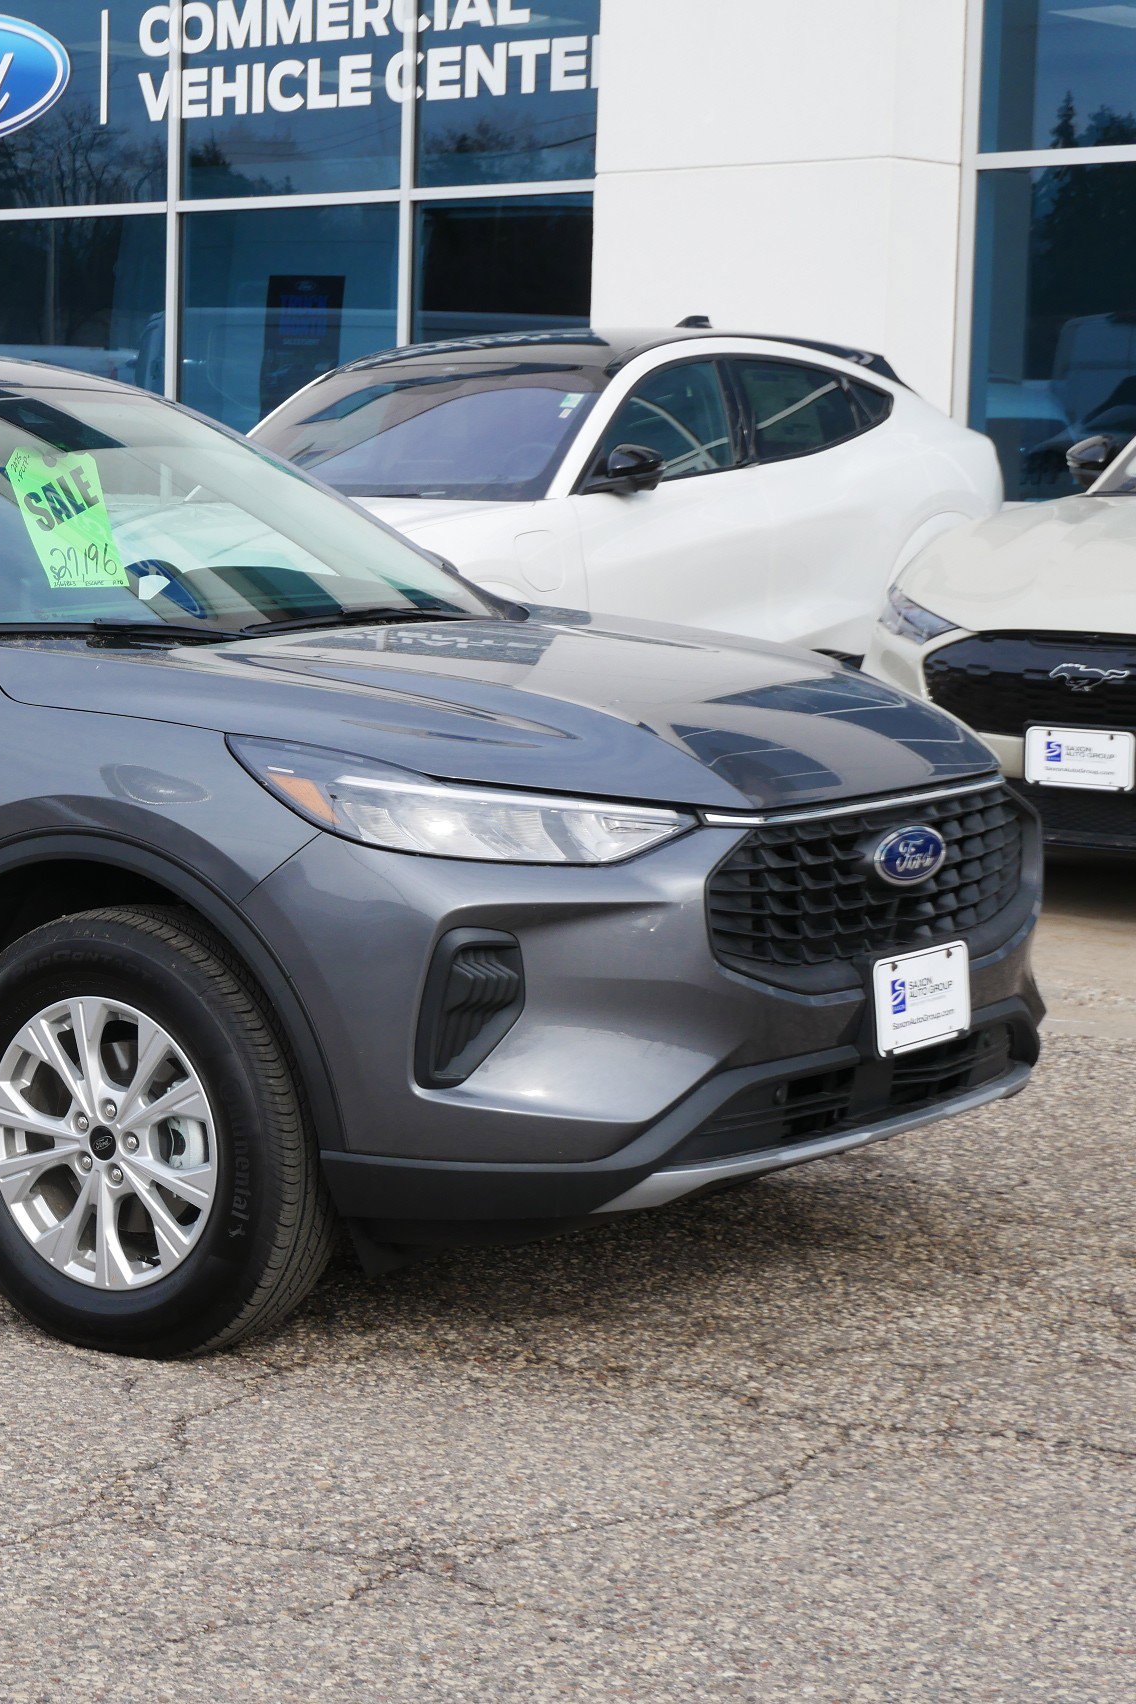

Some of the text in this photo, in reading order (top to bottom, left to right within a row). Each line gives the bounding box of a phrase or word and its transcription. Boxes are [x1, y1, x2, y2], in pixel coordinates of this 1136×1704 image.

[138, 0, 531, 56] COMMERCIAL
[137, 34, 599, 122] VEHICLE CENTE
[24, 465, 100, 531] SALE
[1088, 752, 1115, 760] GROUP
[895, 839, 934, 872] Ford
[908, 977, 933, 991] SAXON
[908, 980, 953, 998] AUTO GROUP
